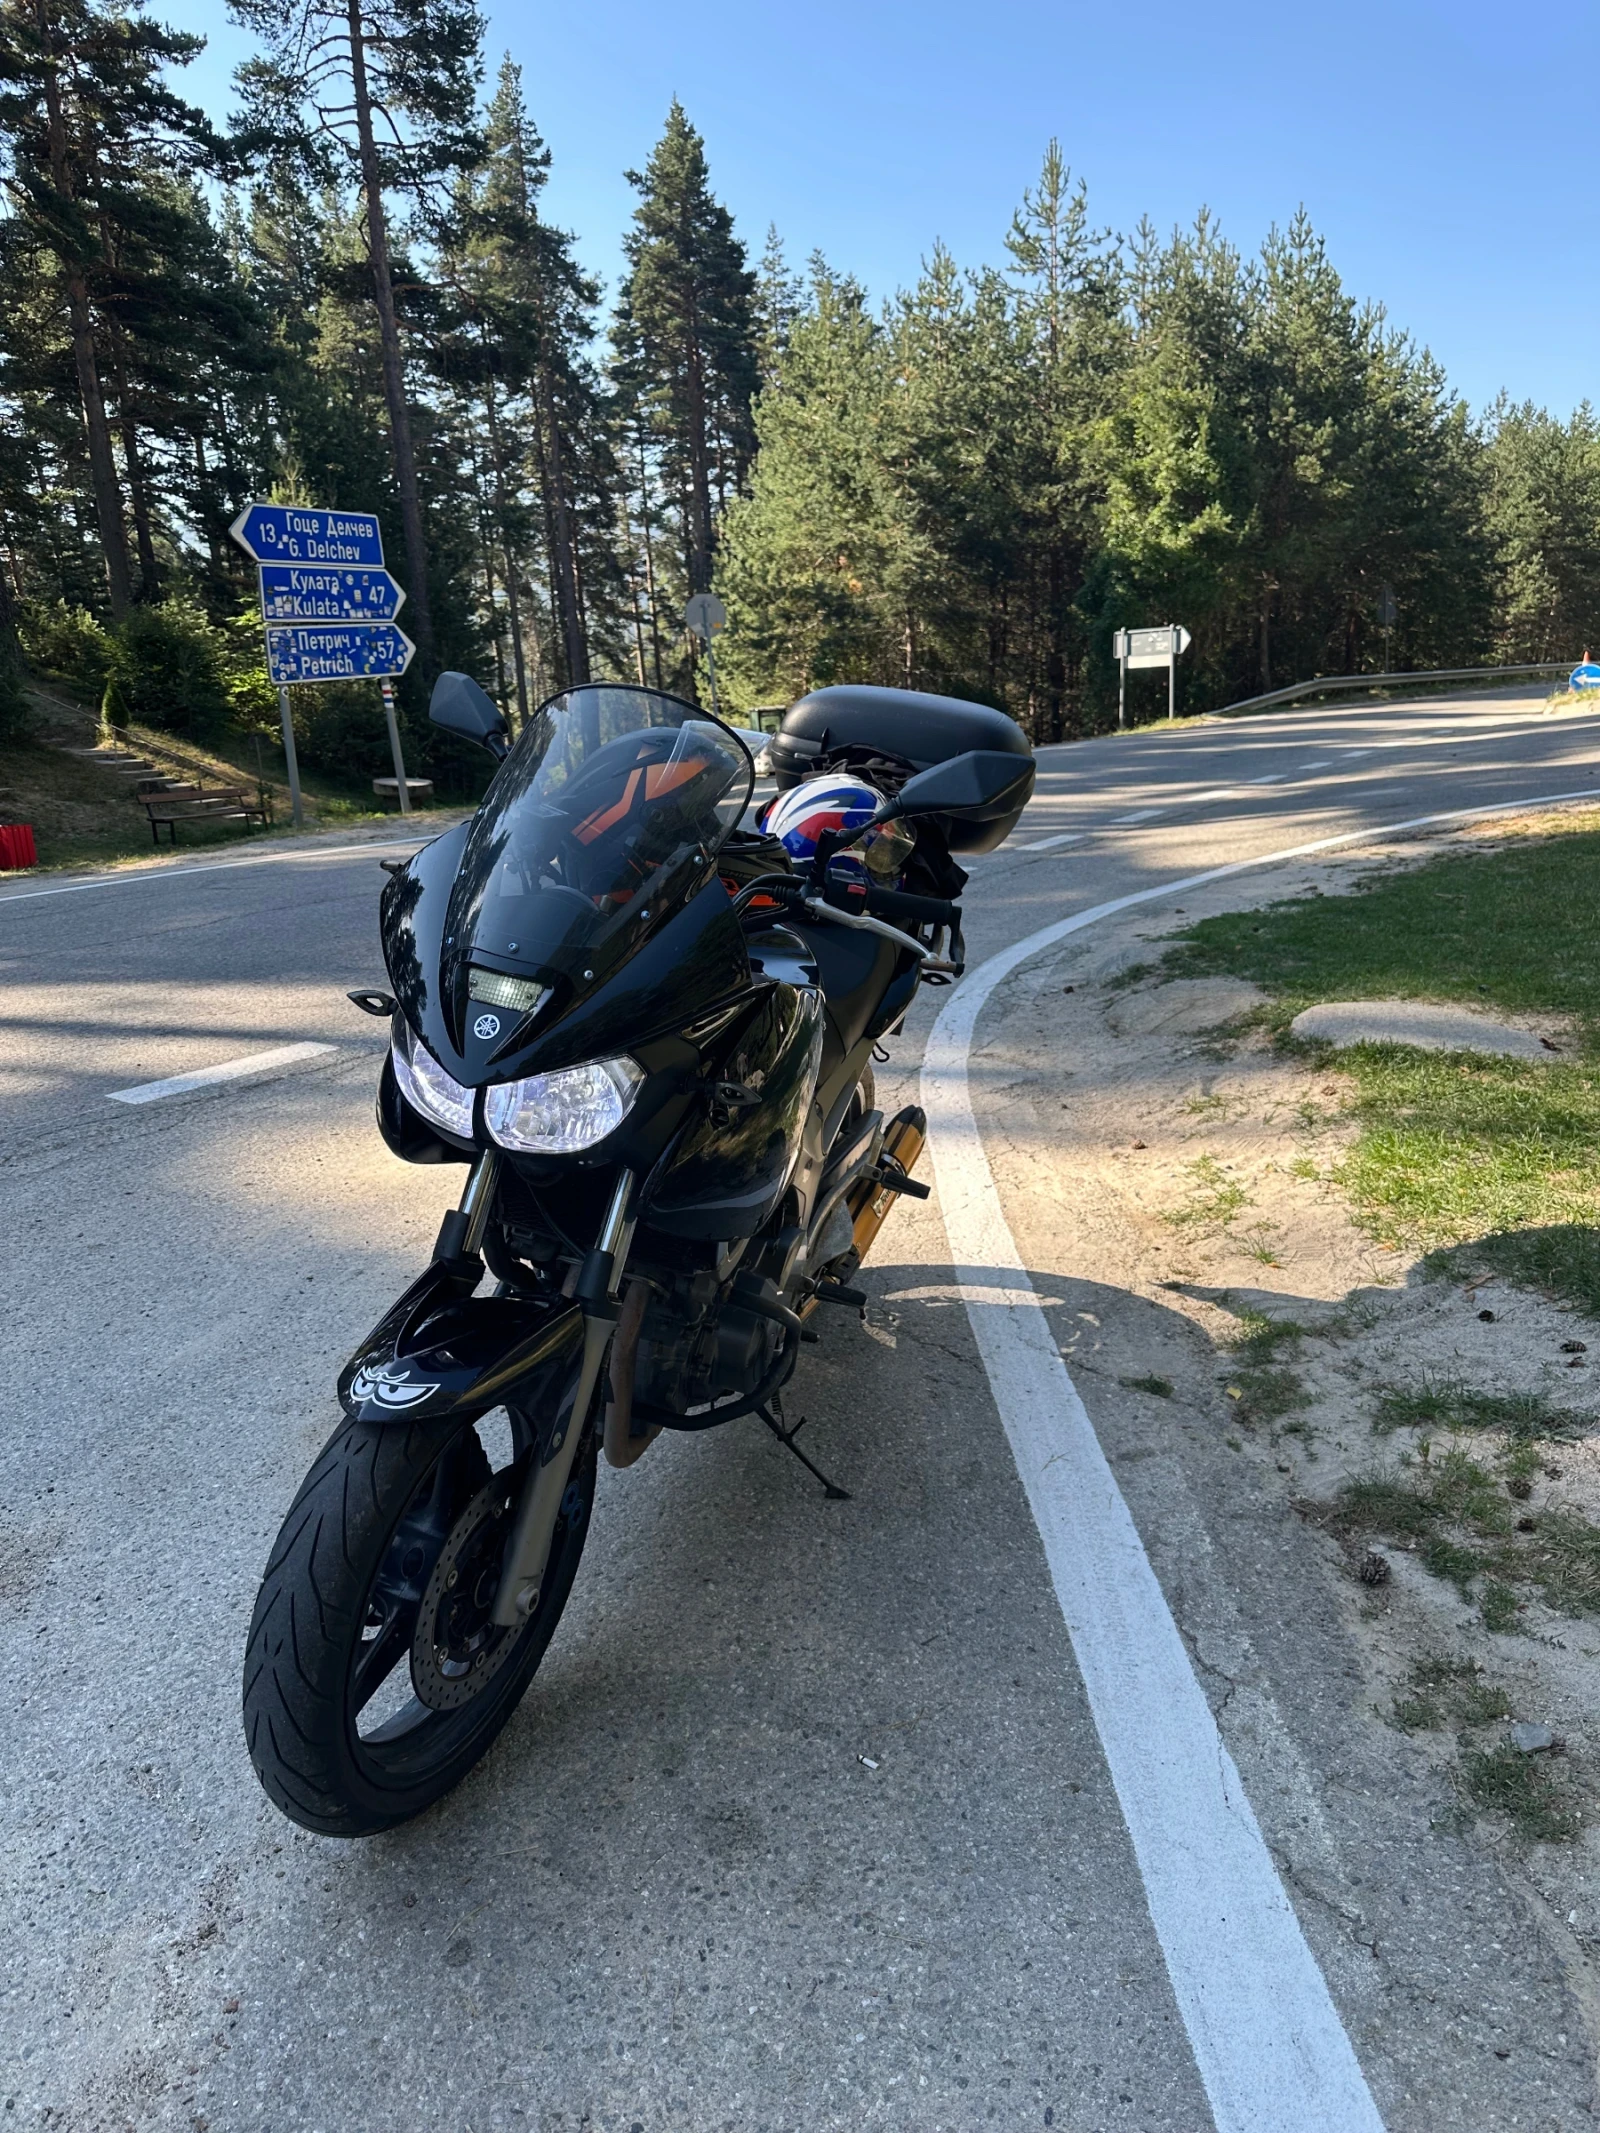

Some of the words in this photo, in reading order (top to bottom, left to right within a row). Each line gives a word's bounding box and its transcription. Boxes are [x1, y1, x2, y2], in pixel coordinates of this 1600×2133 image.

[260, 523, 276, 542] 13
[286, 512, 319, 535] Гоце
[327, 516, 373, 538] Делчев
[289, 540, 302, 557] G.
[308, 540, 360, 560] Delchev
[290, 570, 339, 594] Кулата
[369, 586, 385, 604] 47
[294, 596, 339, 616] Kulata
[298, 632, 350, 653] Петрич
[377, 641, 394, 659] 57
[301, 655, 353, 675] Petrich
